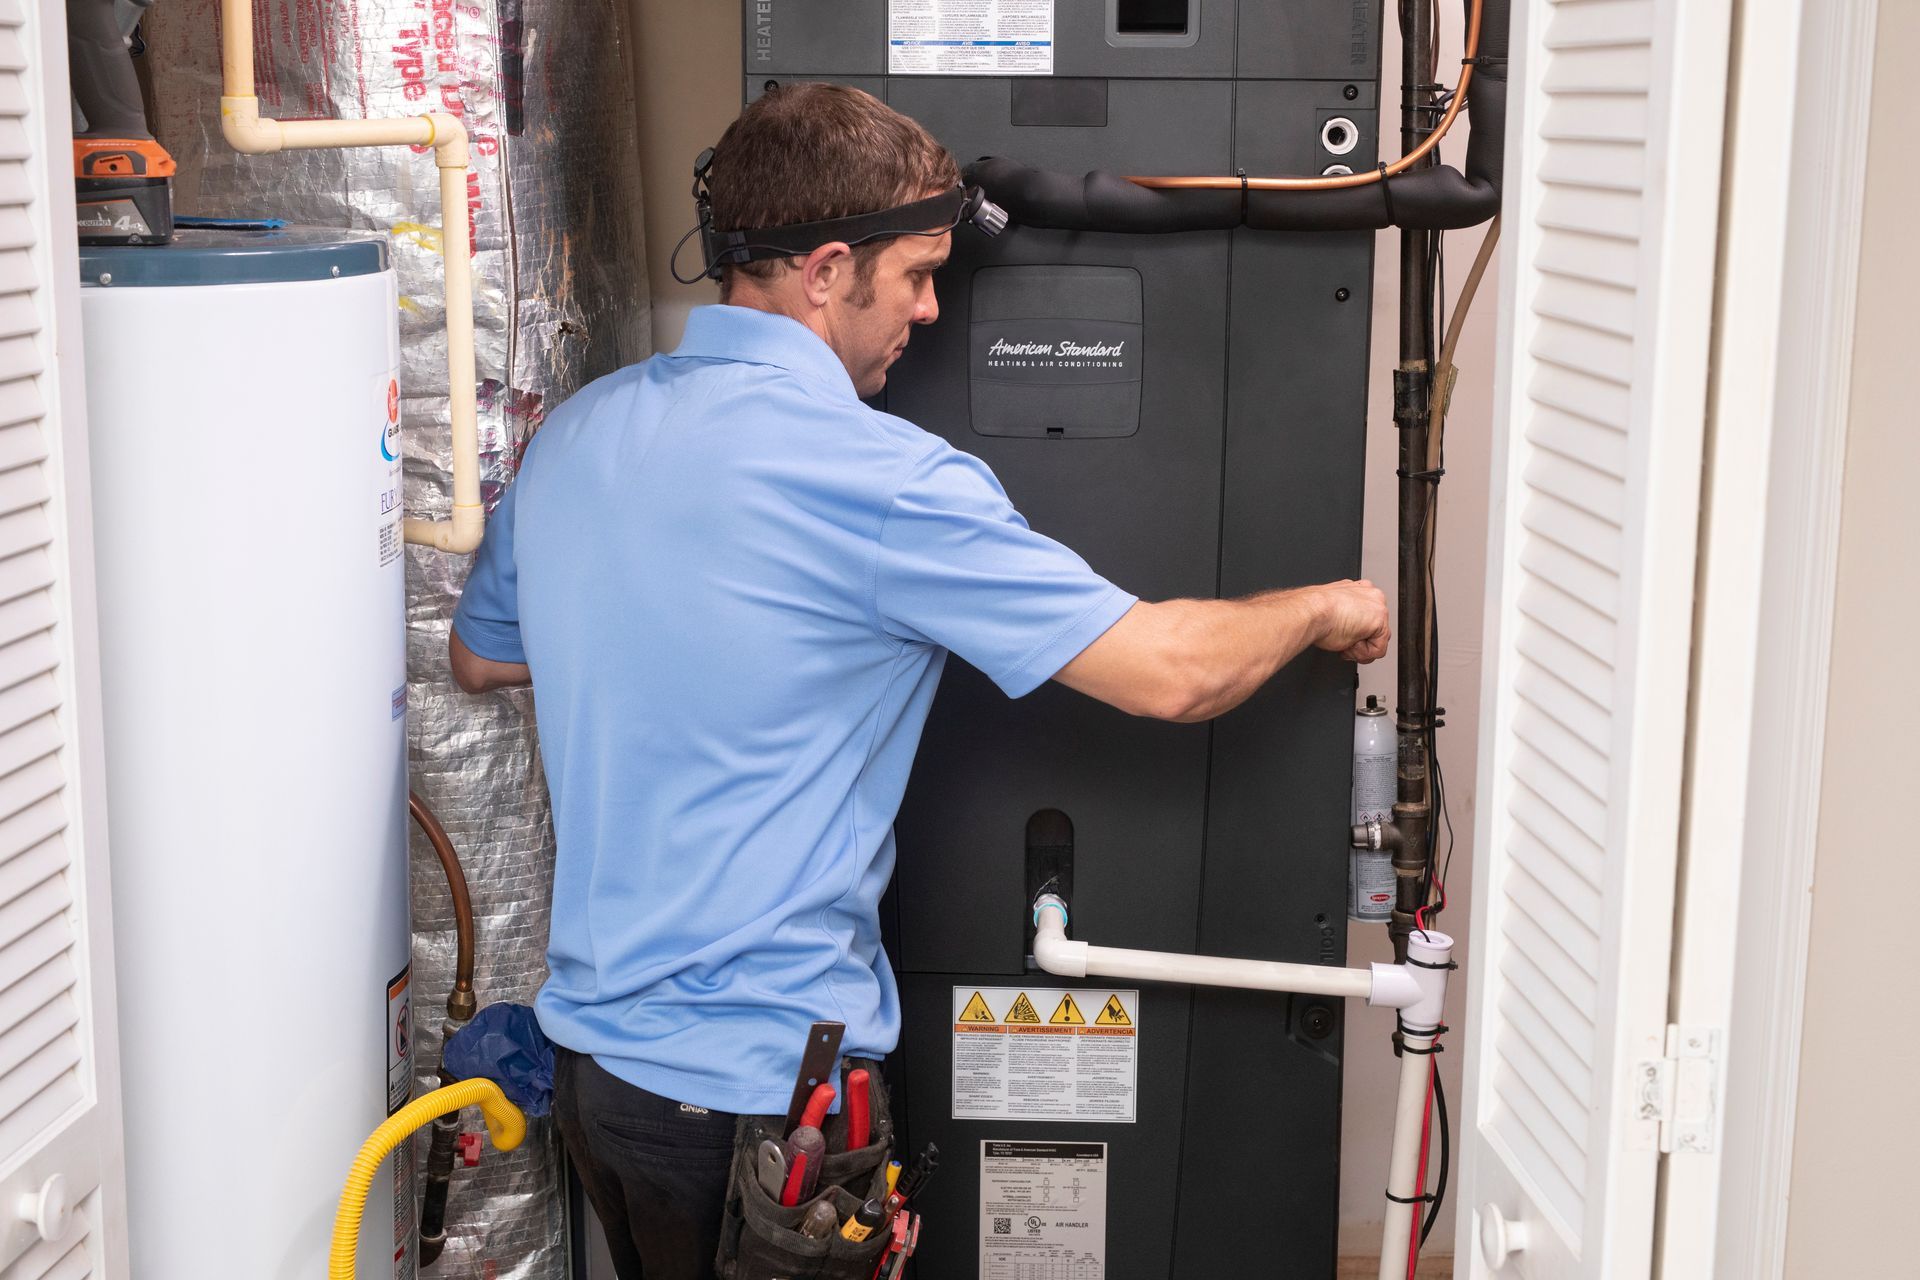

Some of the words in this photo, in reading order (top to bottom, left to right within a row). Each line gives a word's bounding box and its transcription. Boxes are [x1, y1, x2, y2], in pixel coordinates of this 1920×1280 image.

[757, 0, 772, 61] HEATE
[392, 21, 431, 102] Type
[988, 338, 1052, 356] American
[1055, 341, 1125, 357] Standard
[1321, 928, 1337, 964] COIL
[968, 1025, 1000, 1033] WARNING
